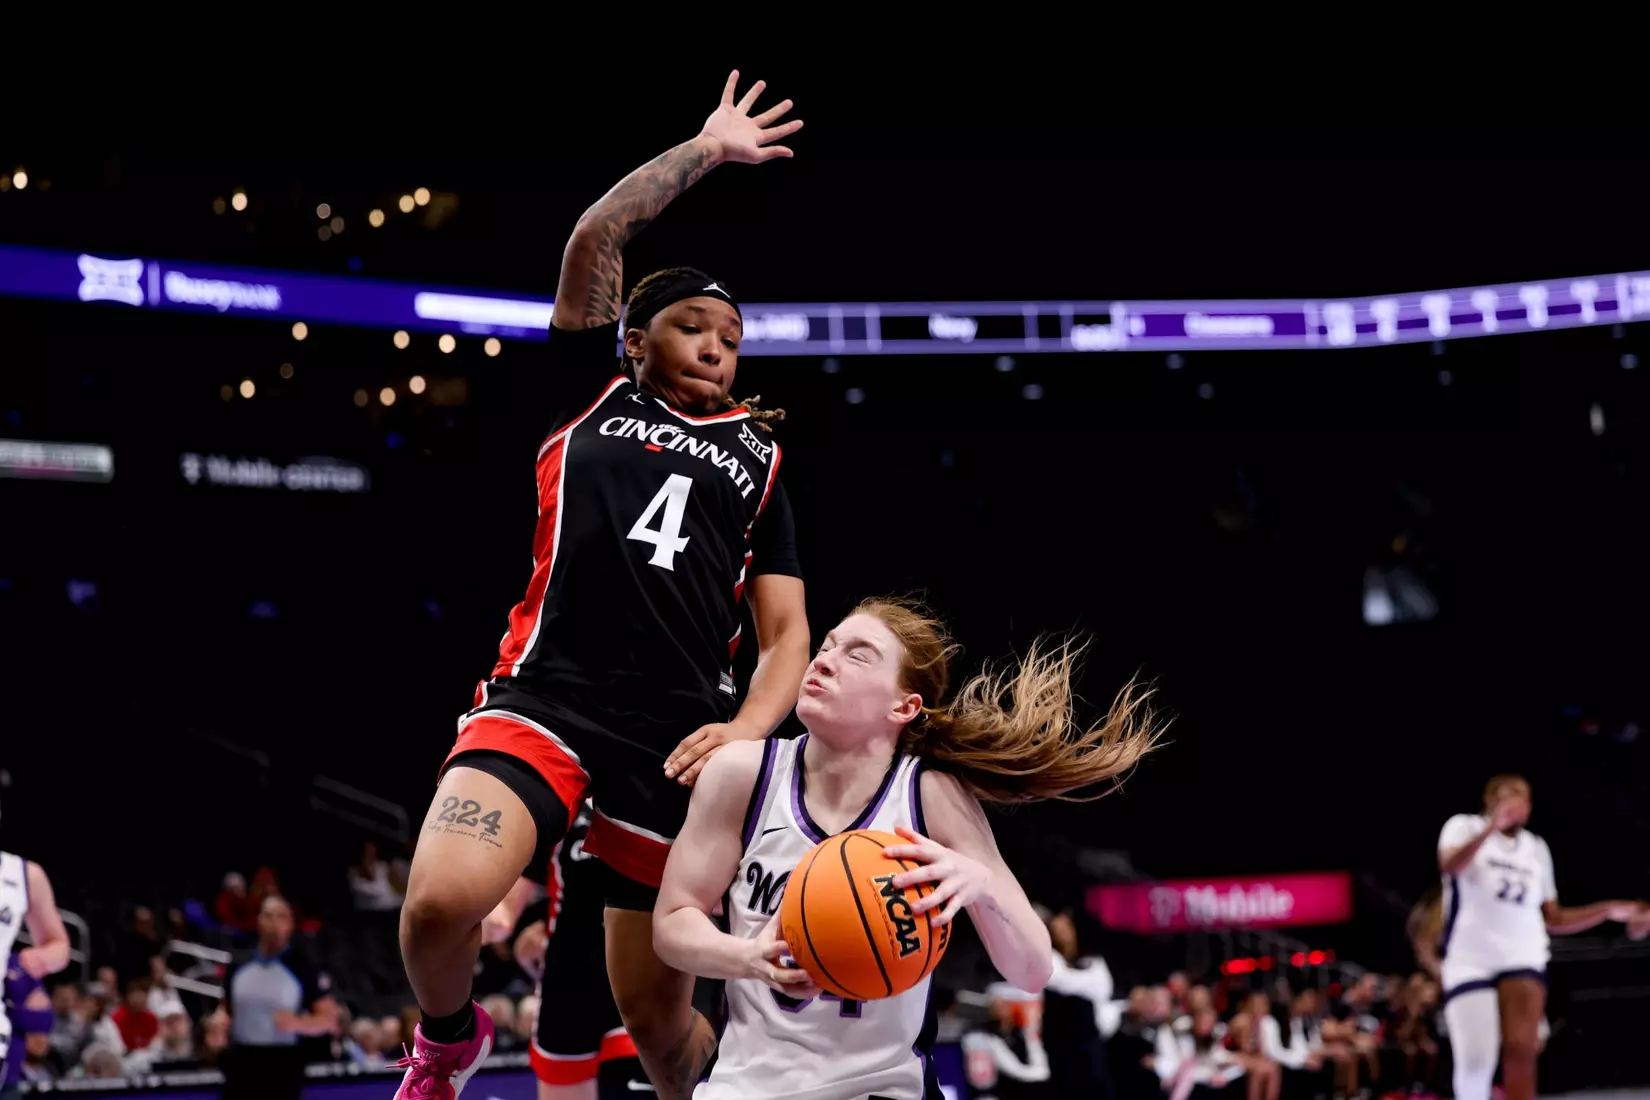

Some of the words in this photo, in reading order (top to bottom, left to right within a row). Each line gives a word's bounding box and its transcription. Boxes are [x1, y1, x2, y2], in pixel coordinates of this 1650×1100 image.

[599, 416, 755, 499] CINCINNATI
[626, 473, 693, 571] 4
[437, 796, 502, 836] 224
[872, 873, 922, 959] NCAA
